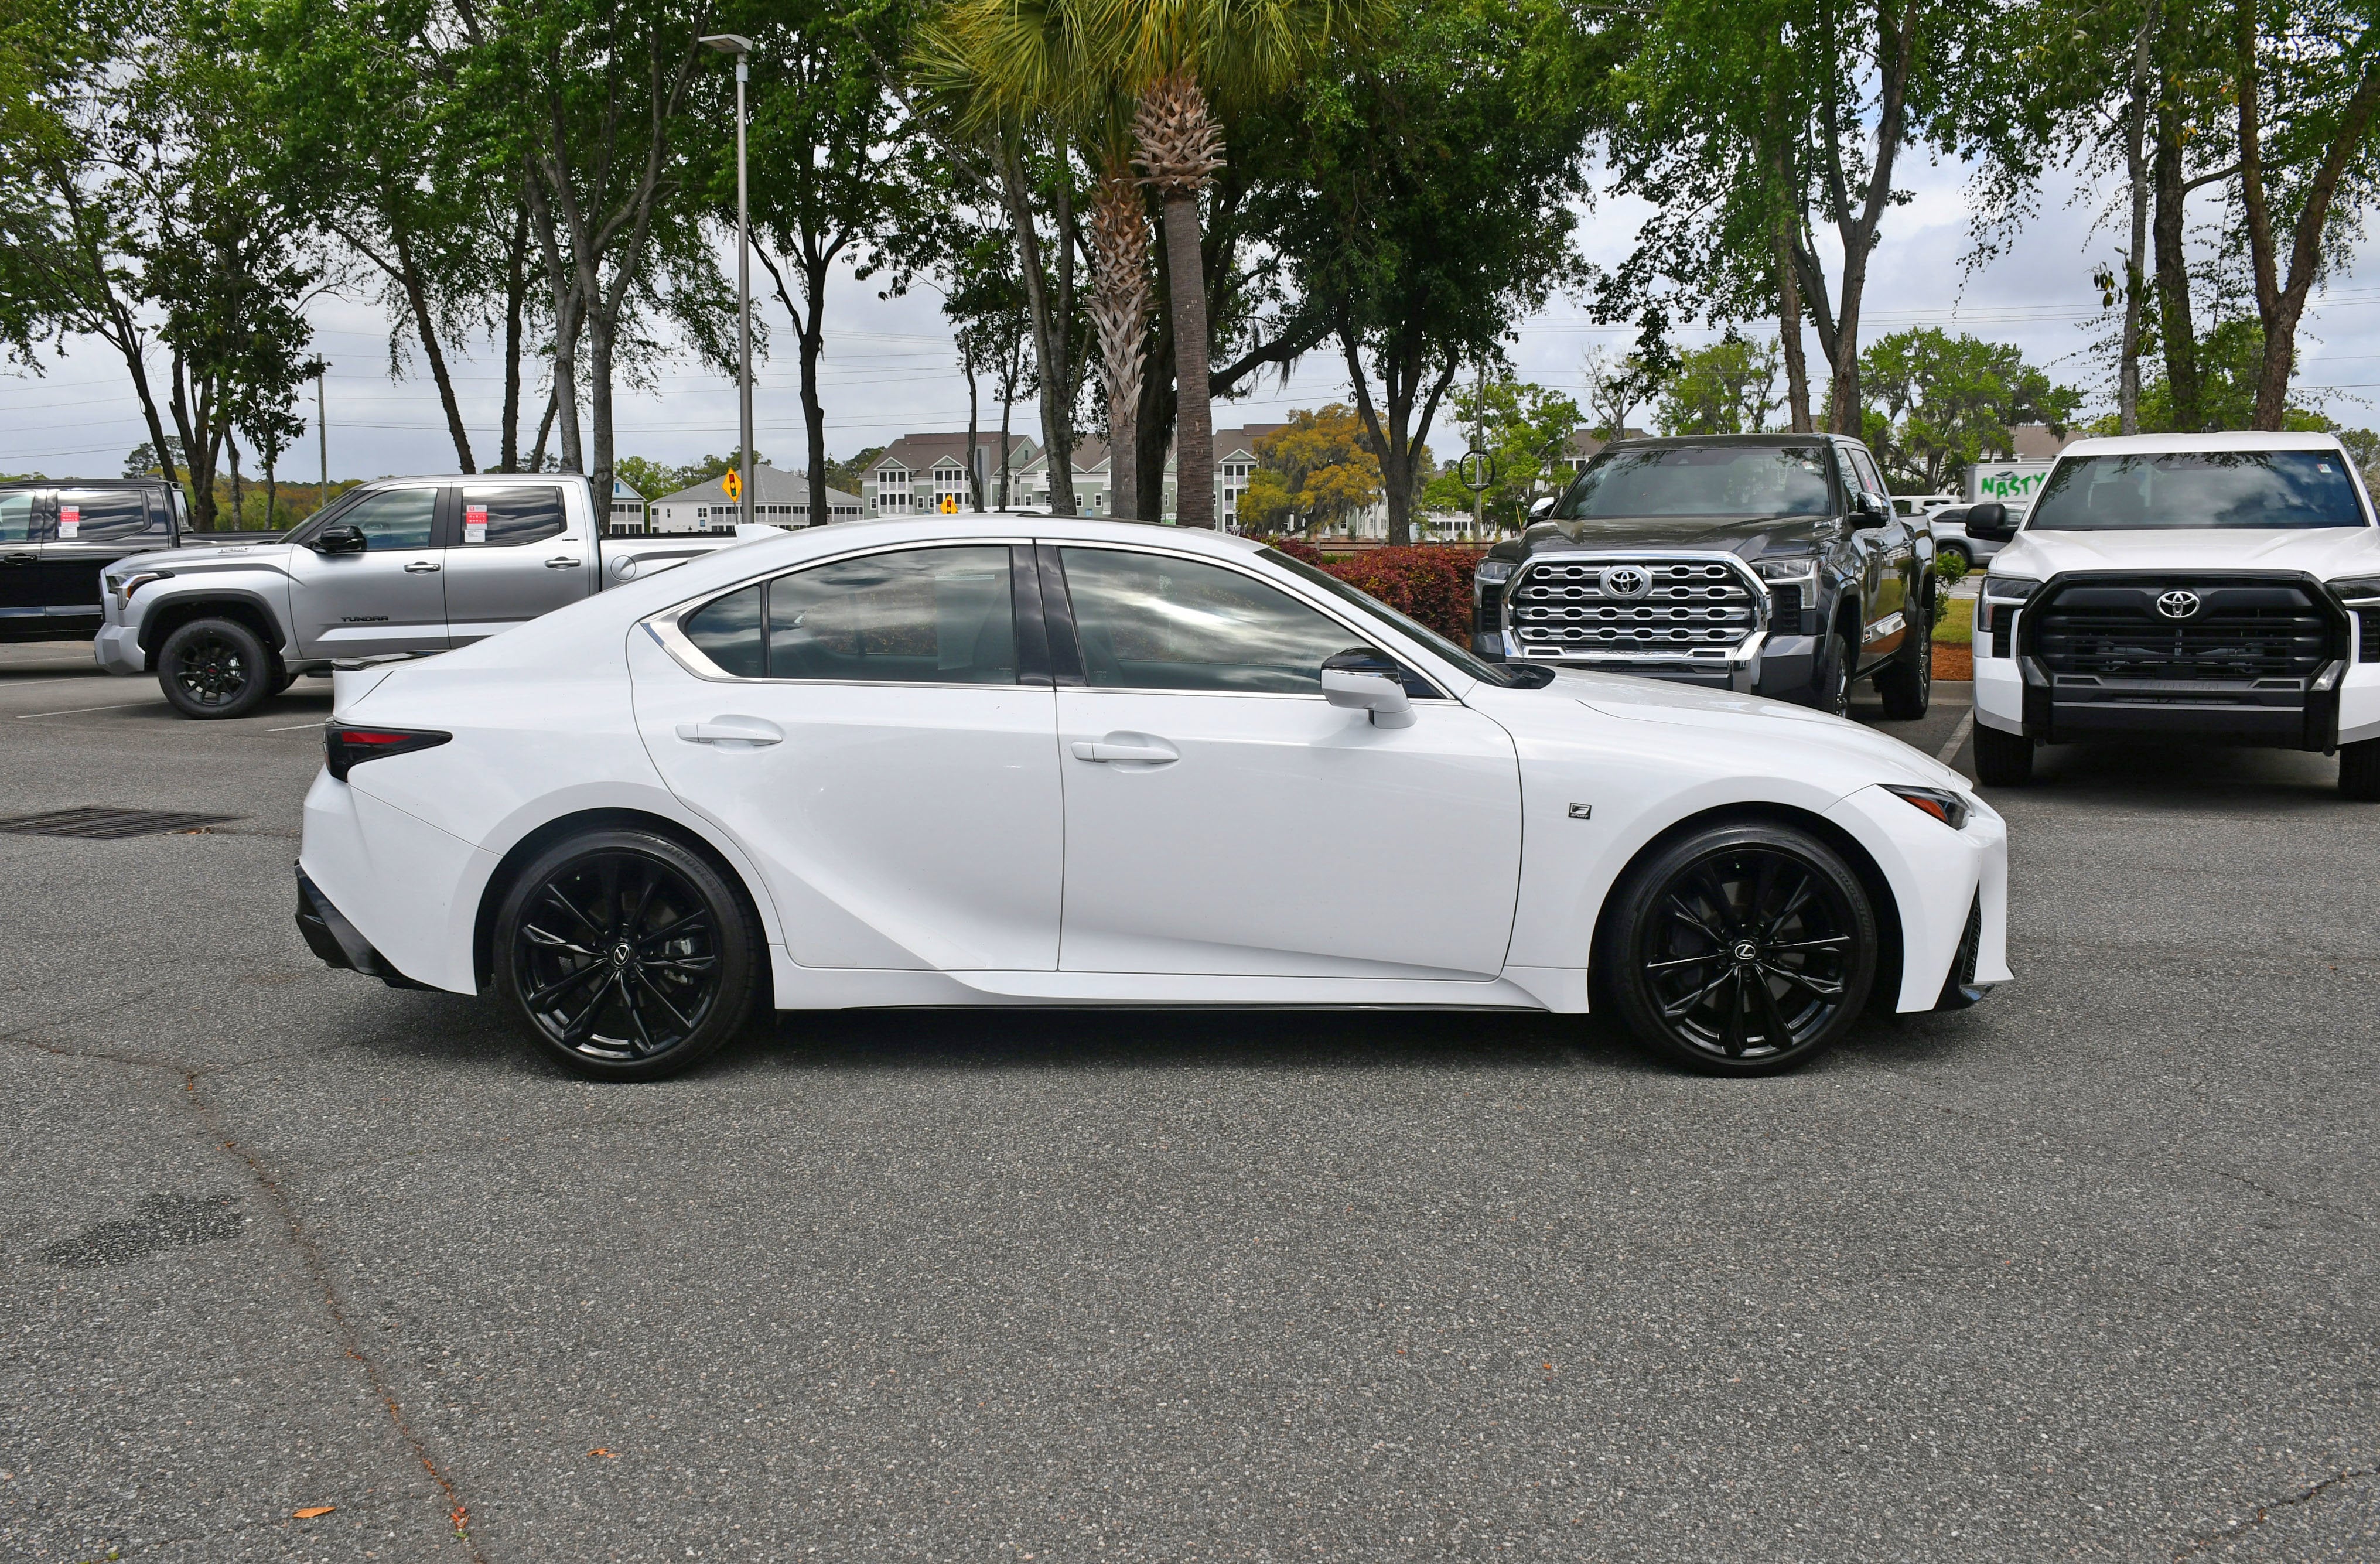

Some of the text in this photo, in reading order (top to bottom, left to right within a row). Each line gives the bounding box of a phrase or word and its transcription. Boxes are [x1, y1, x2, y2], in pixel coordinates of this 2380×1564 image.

[1981, 471, 2047, 500] NASTY
[661, 843, 733, 916] BRIDGESTO
[1832, 863, 1873, 945] RIDGESTONE
